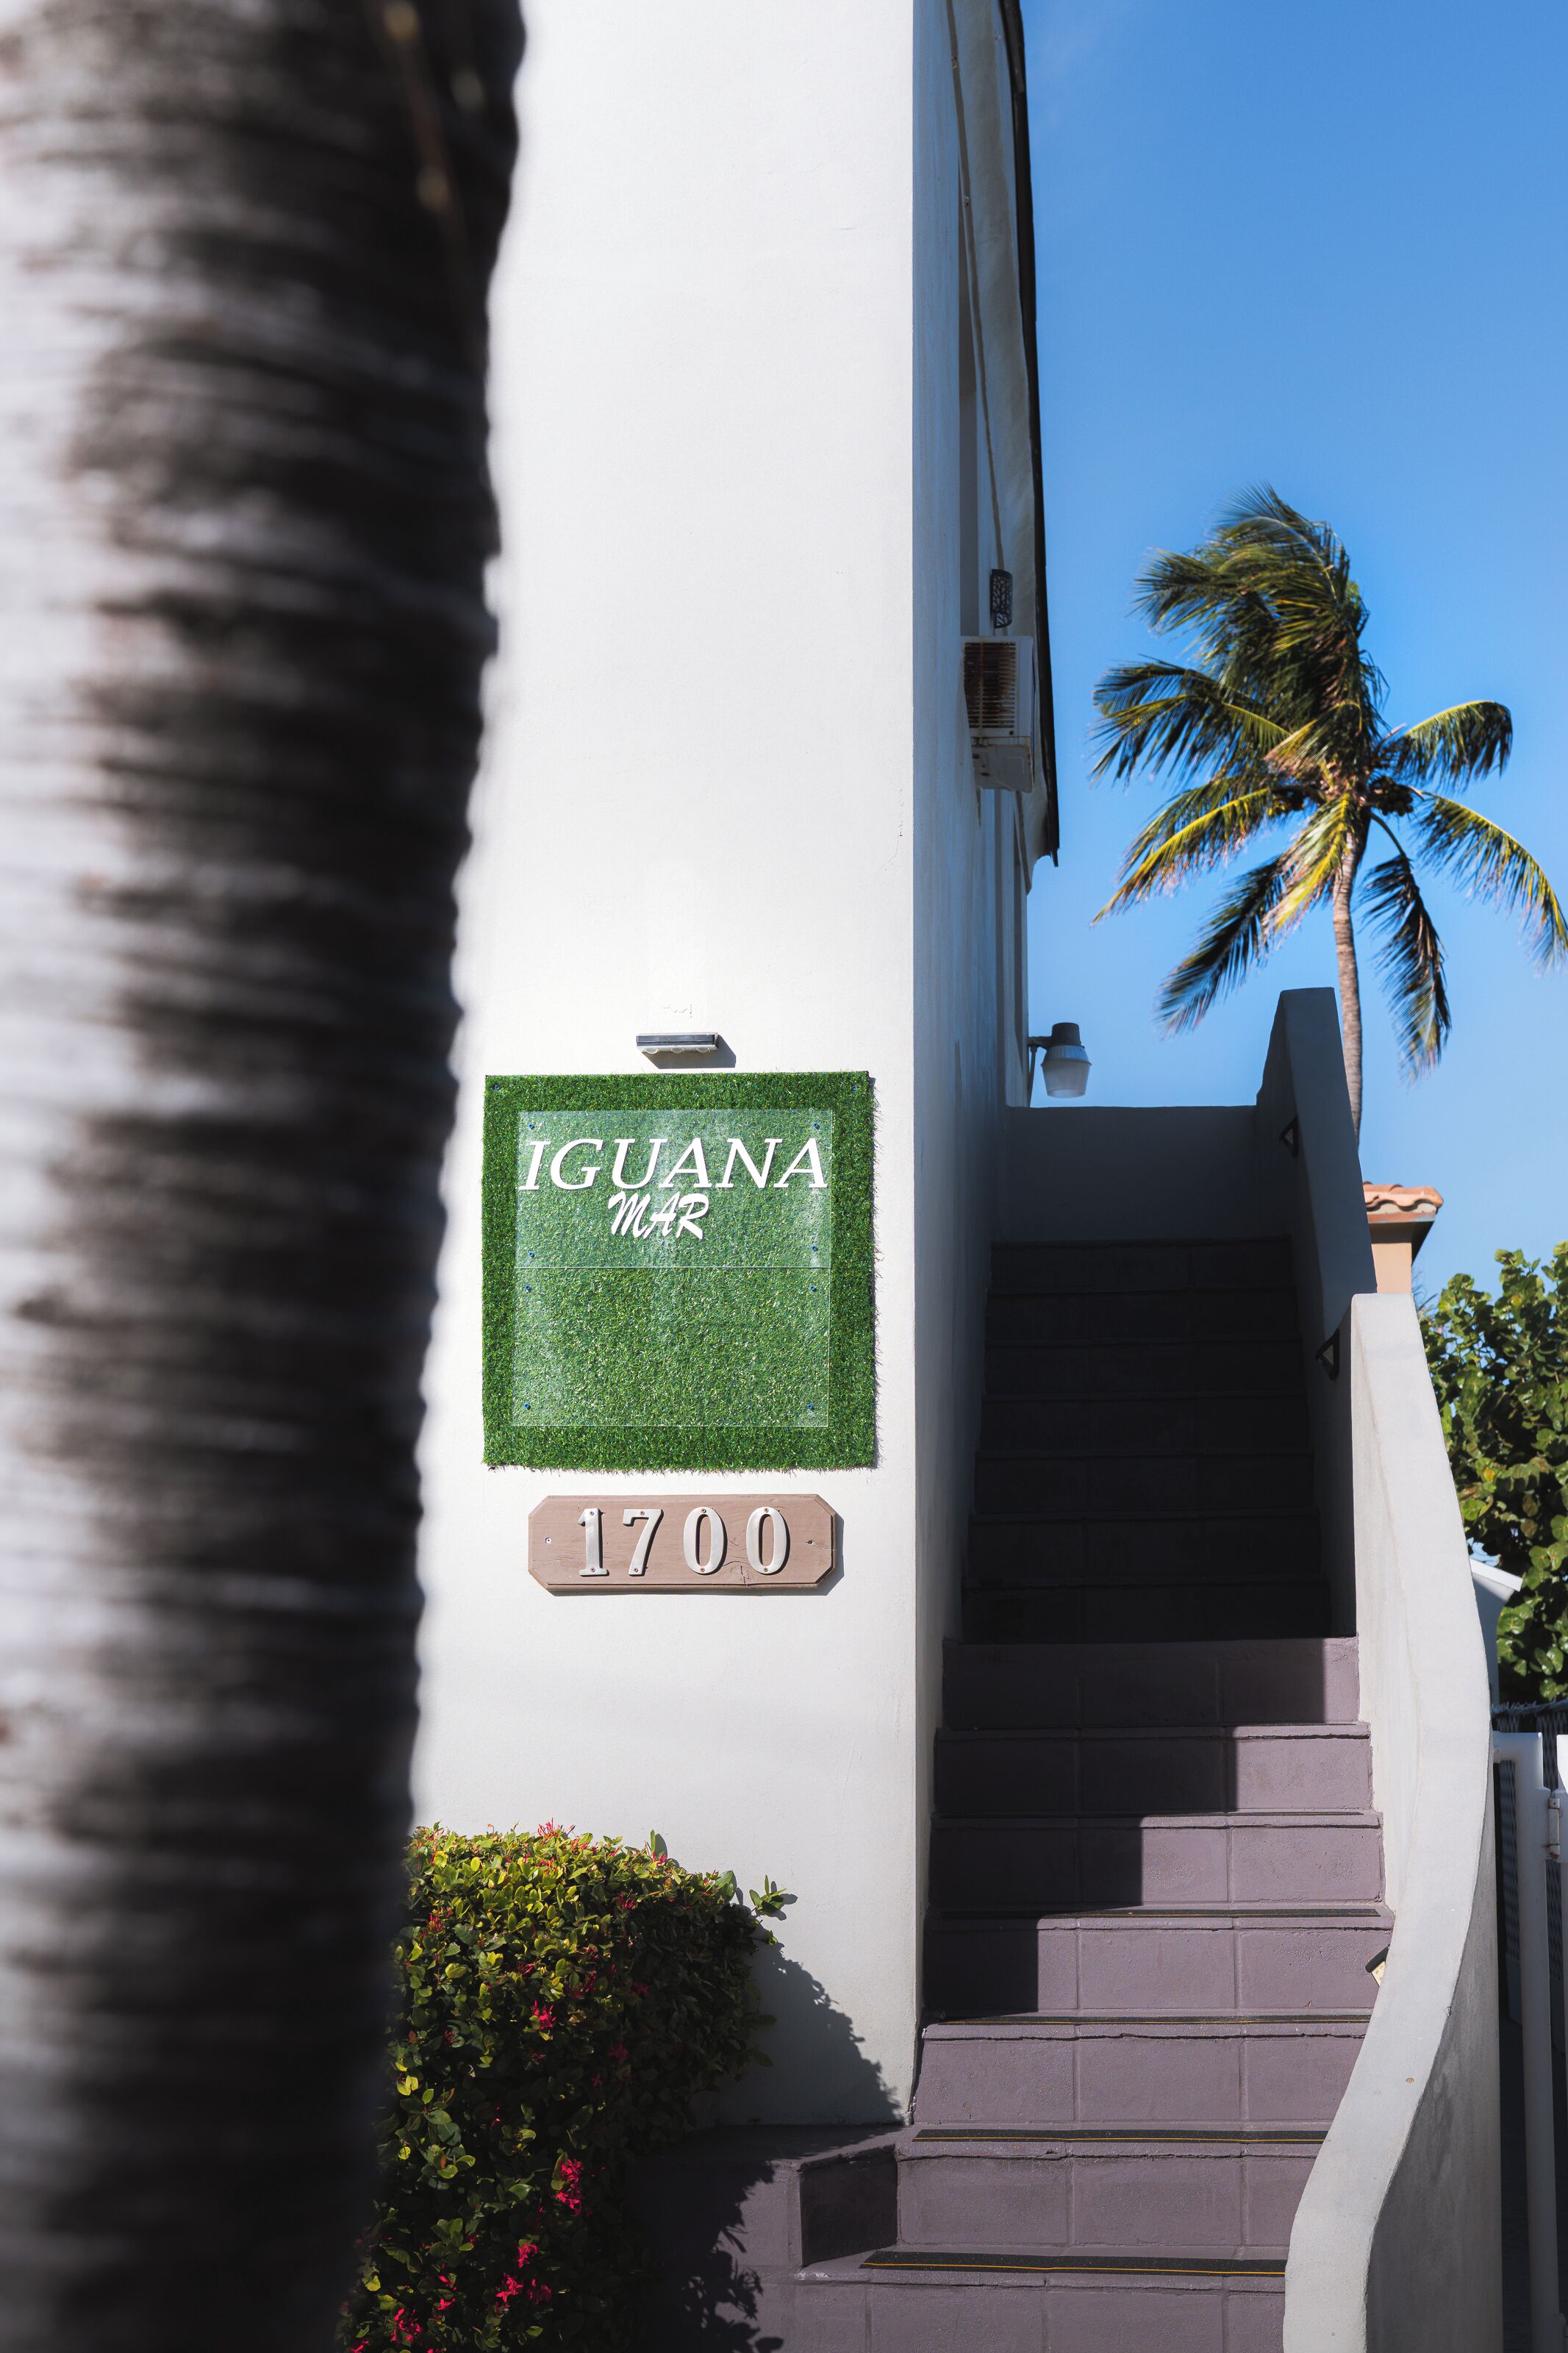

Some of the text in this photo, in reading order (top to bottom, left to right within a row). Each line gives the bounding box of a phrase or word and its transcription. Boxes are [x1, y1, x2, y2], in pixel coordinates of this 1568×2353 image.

[518, 1138, 828, 1191] IGUANA
[608, 1190, 709, 1240] MAR
[578, 1507, 789, 1576] 1700
